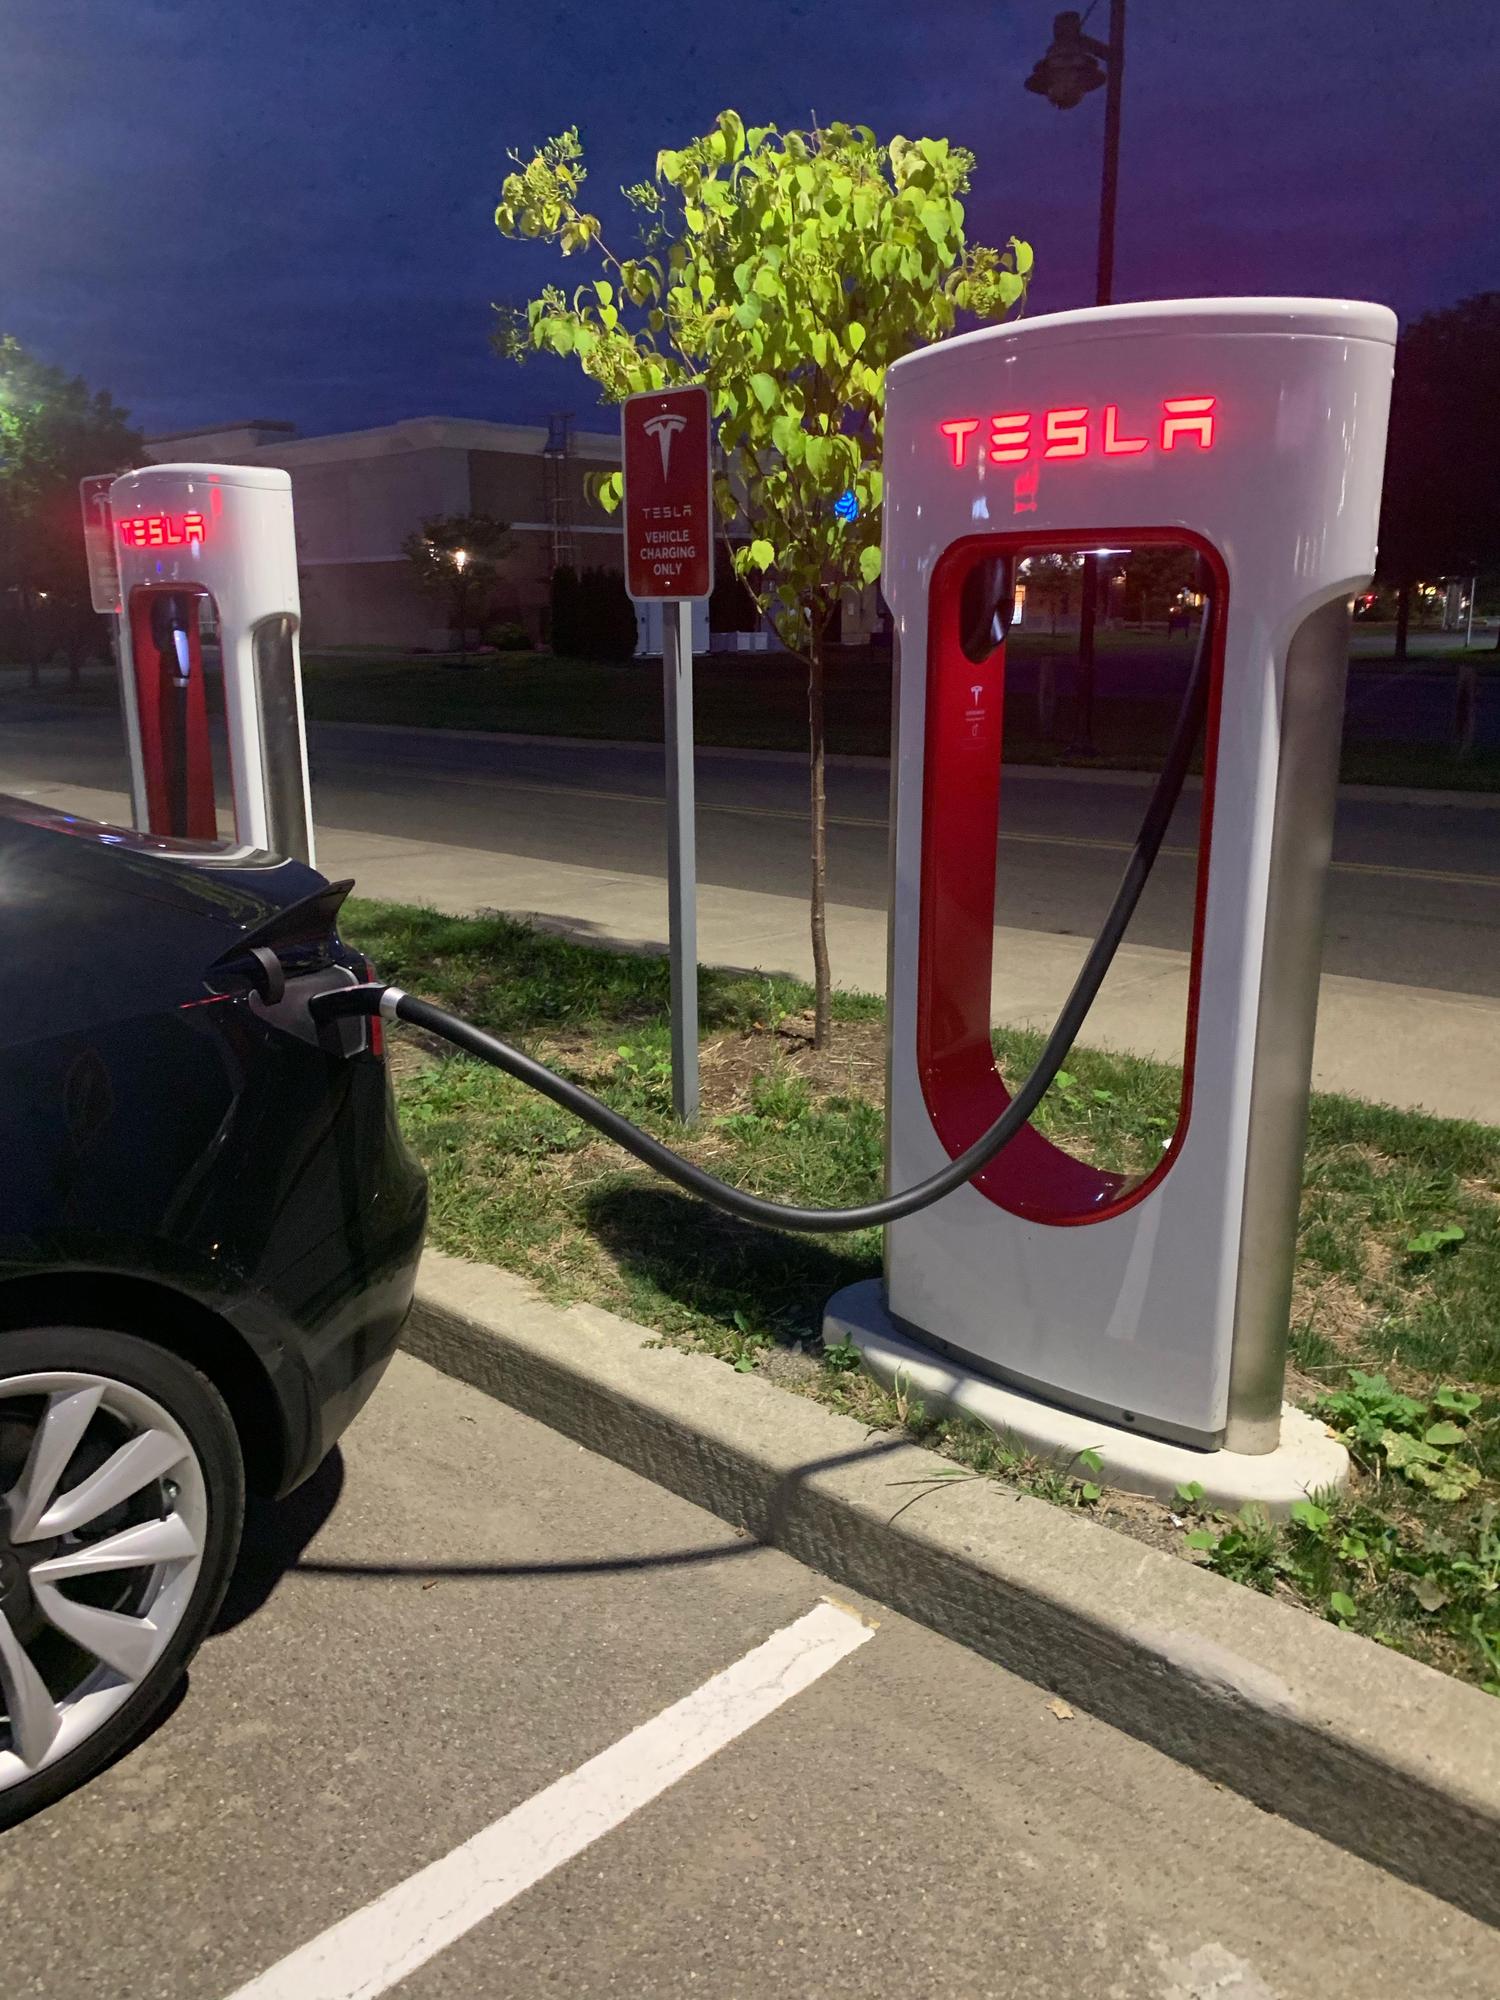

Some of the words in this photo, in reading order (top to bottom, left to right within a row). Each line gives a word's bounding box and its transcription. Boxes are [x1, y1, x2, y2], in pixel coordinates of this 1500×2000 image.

[940, 396, 1216, 467] TESLA
[641, 504, 692, 519] TESLA
[120, 513, 206, 547] TESLA
[645, 529, 690, 544] VEHICLE
[640, 545, 696, 560] CHARGING
[653, 562, 683, 576] ONLY
